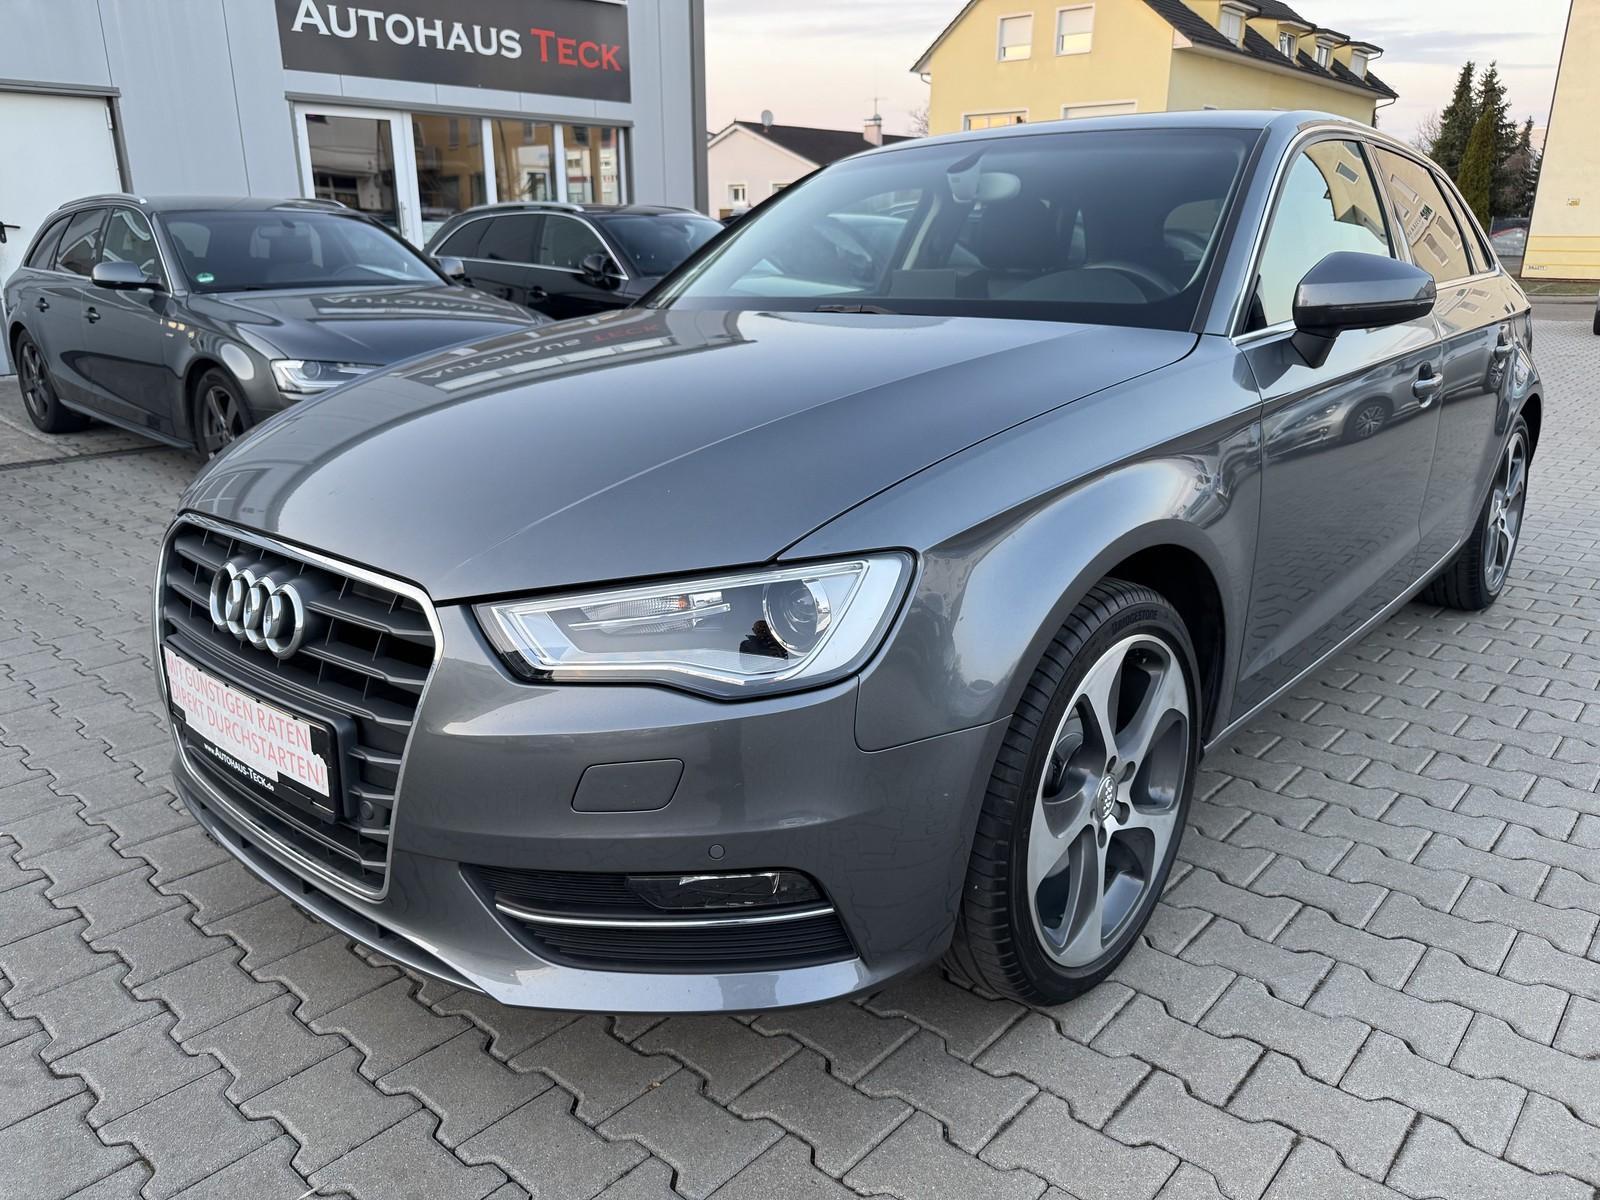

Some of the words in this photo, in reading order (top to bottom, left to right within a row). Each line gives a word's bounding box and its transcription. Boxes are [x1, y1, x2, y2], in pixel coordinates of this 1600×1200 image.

[291, 0, 522, 59] AUTOHAUS
[531, 28, 622, 71] TECK
[171, 680, 205, 721] DIREKT
[207, 705, 326, 789] DURCHSTARTEN!
[257, 707, 309, 752] RATEN
